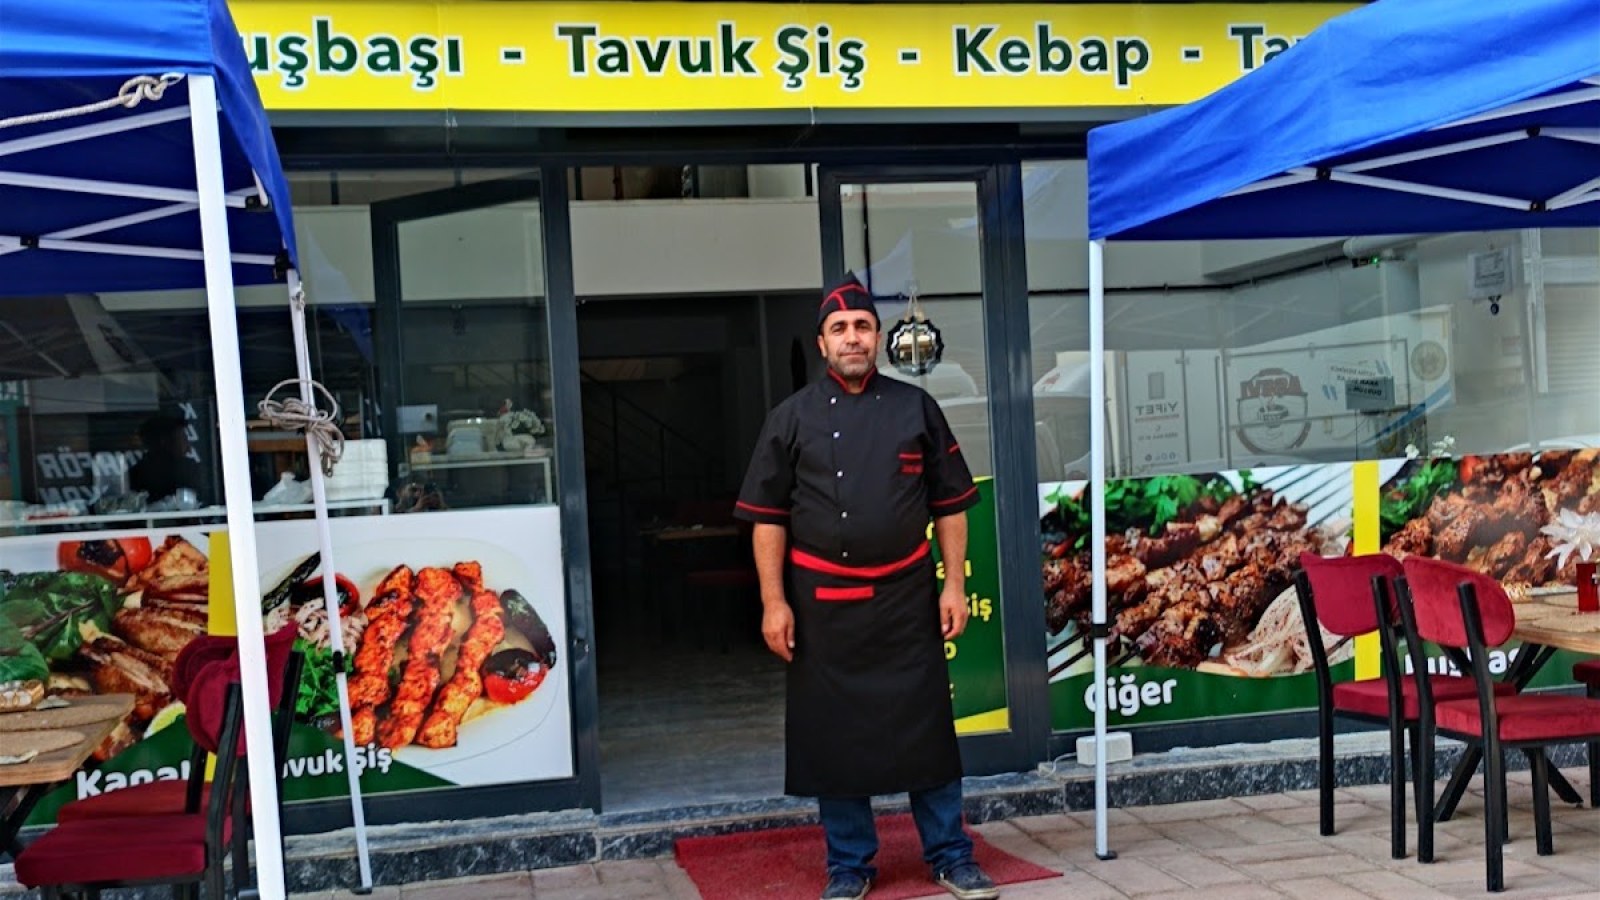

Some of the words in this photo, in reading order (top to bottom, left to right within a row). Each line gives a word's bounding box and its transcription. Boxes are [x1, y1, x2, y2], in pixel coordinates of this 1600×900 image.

[240, 19, 461, 88] uşbaşı
[557, 23, 757, 74] Tavuk
[776, 25, 865, 89] Şiş
[954, 24, 1150, 86] Kebap
[1229, 26, 1302, 70] Ta
[965, 592, 993, 622] iş
[283, 748, 344, 779] vuk
